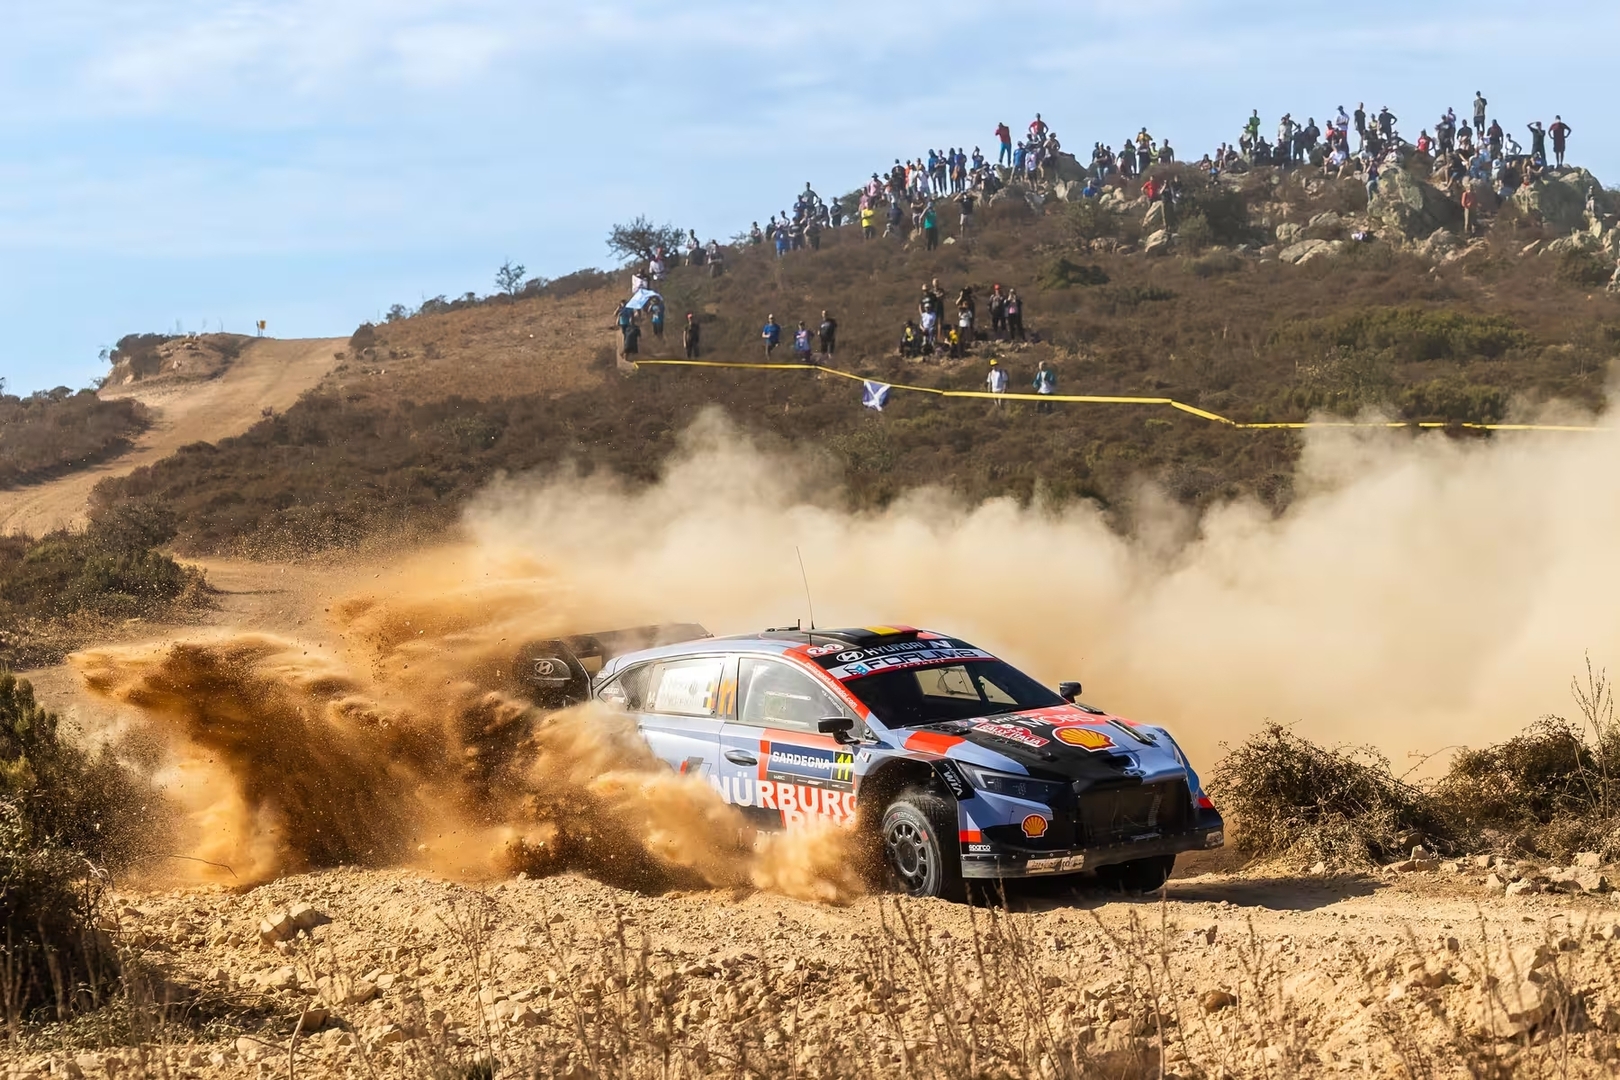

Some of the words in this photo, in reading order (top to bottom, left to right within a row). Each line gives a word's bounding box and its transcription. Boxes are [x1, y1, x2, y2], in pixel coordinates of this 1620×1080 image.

[864, 641, 926, 656] HYUNDAI
[864, 649, 979, 670] FORUM8
[771, 751, 831, 770] SARDEGNA
[837, 753, 852, 780] 11
[968, 844, 991, 852] sparco
